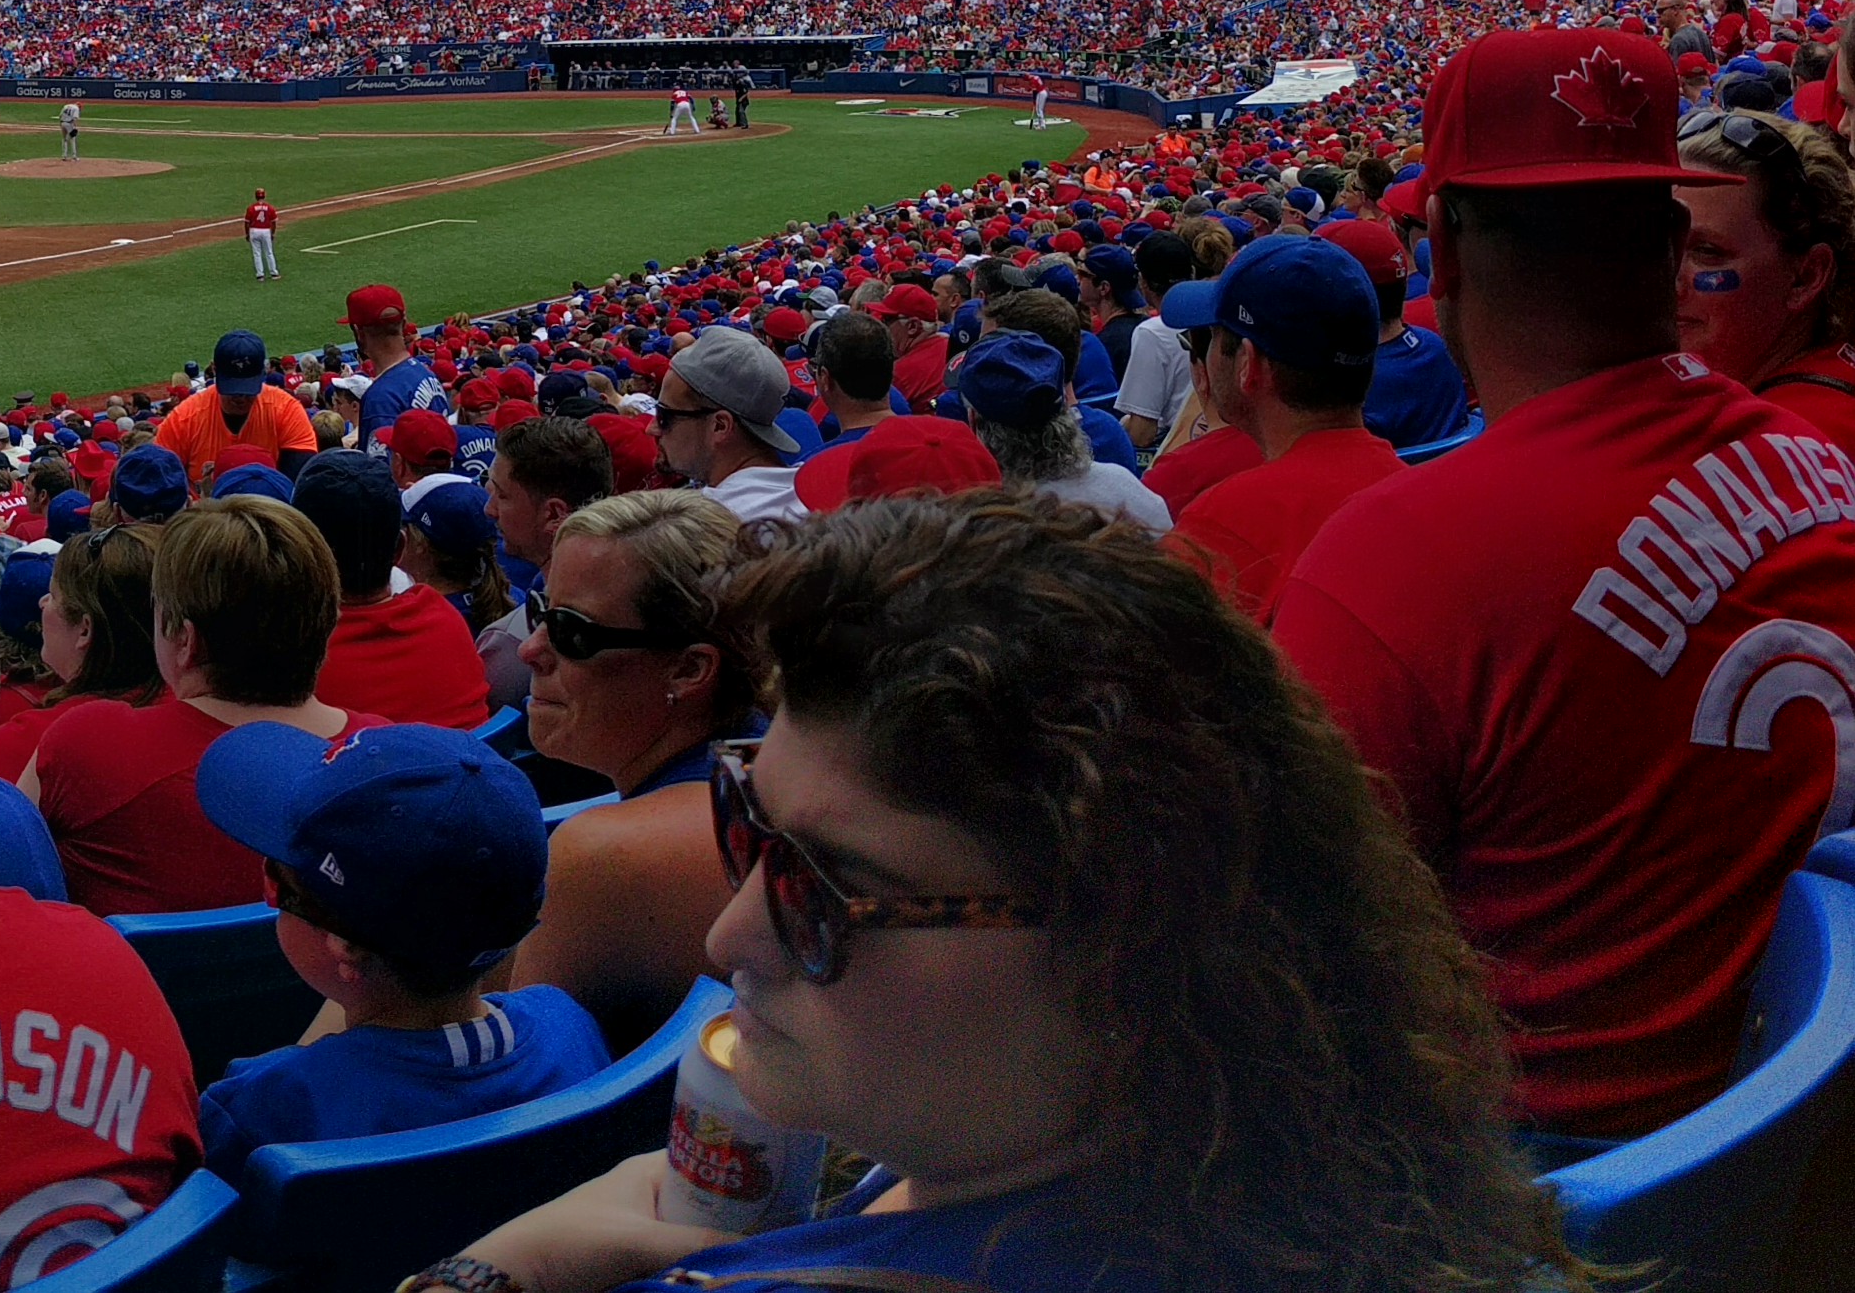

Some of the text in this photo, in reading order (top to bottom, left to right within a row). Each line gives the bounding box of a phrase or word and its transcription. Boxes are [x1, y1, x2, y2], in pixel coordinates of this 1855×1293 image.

[347, 76, 486, 90] American Standard VorMax
[16, 87, 48, 97] Galaxy
[114, 88, 145, 99] Galaxy
